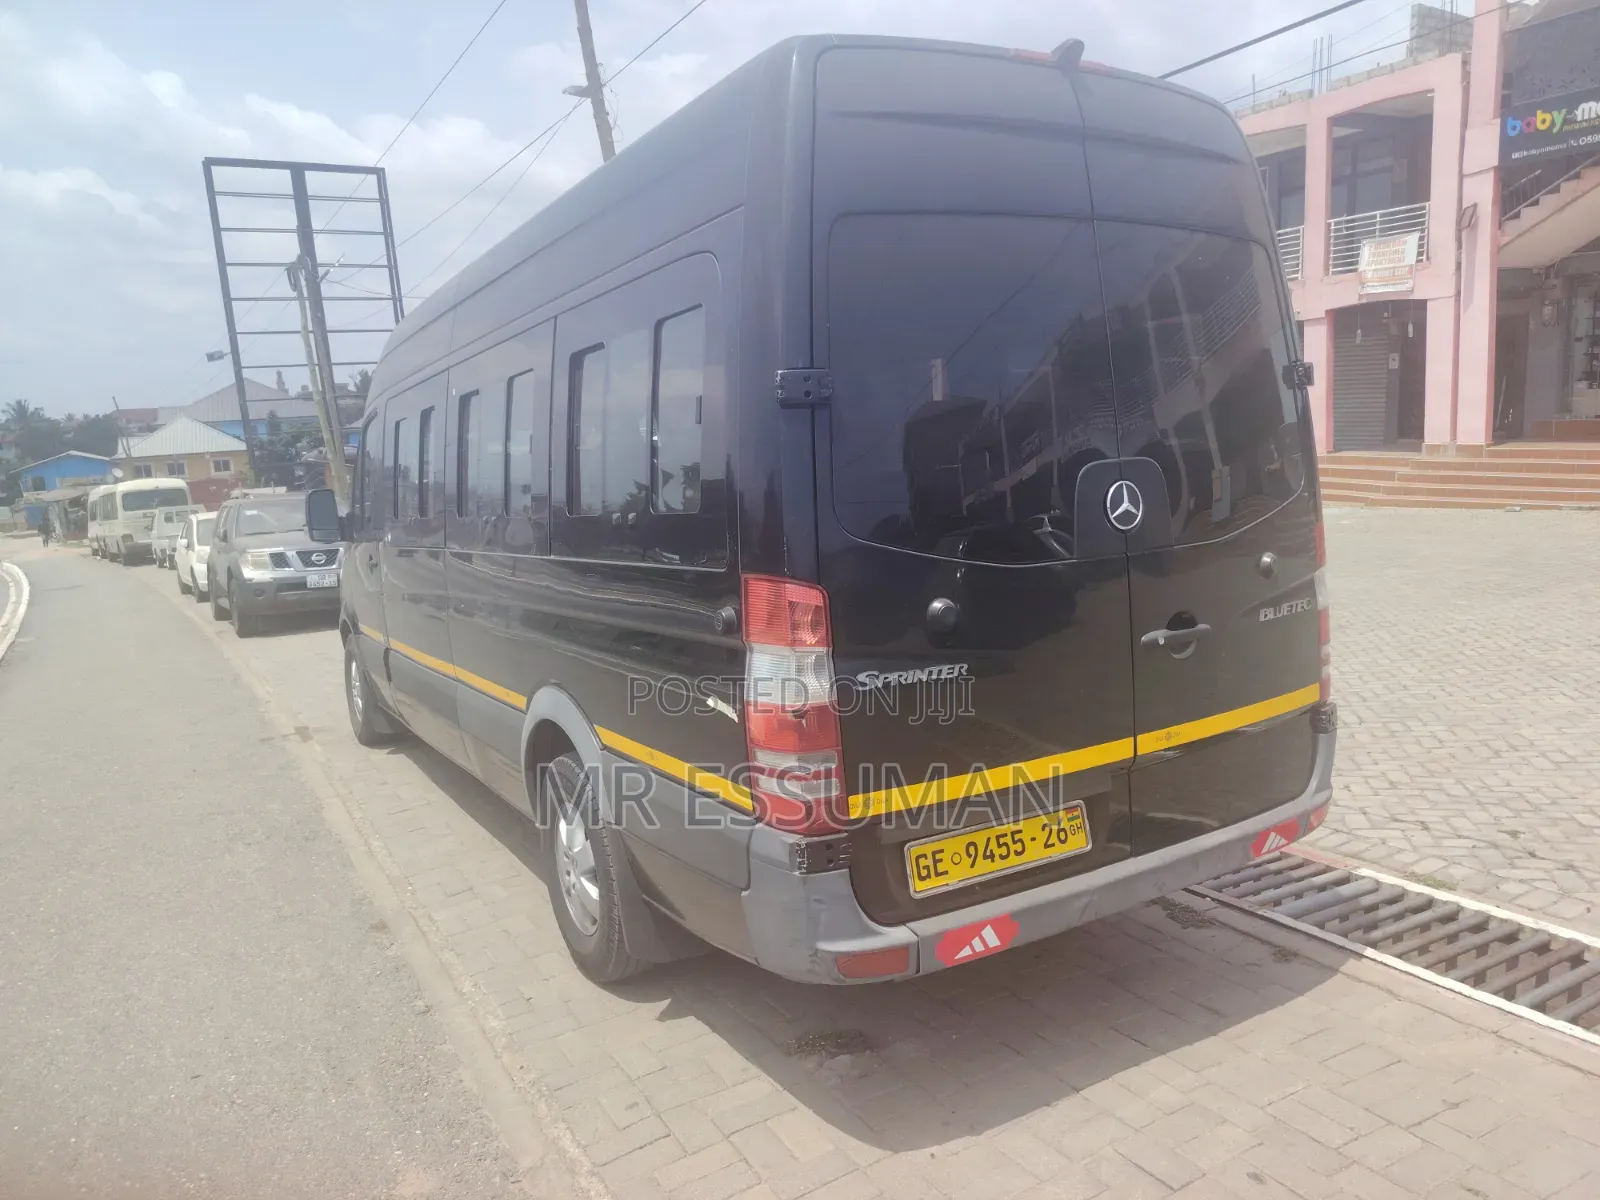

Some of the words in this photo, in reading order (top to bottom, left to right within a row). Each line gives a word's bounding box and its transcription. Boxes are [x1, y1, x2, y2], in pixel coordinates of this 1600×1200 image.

[1506, 109, 1567, 136] baby
[856, 663, 969, 690] SPRINTER
[1069, 821, 1084, 836] GH
[915, 848, 949, 881] GE
